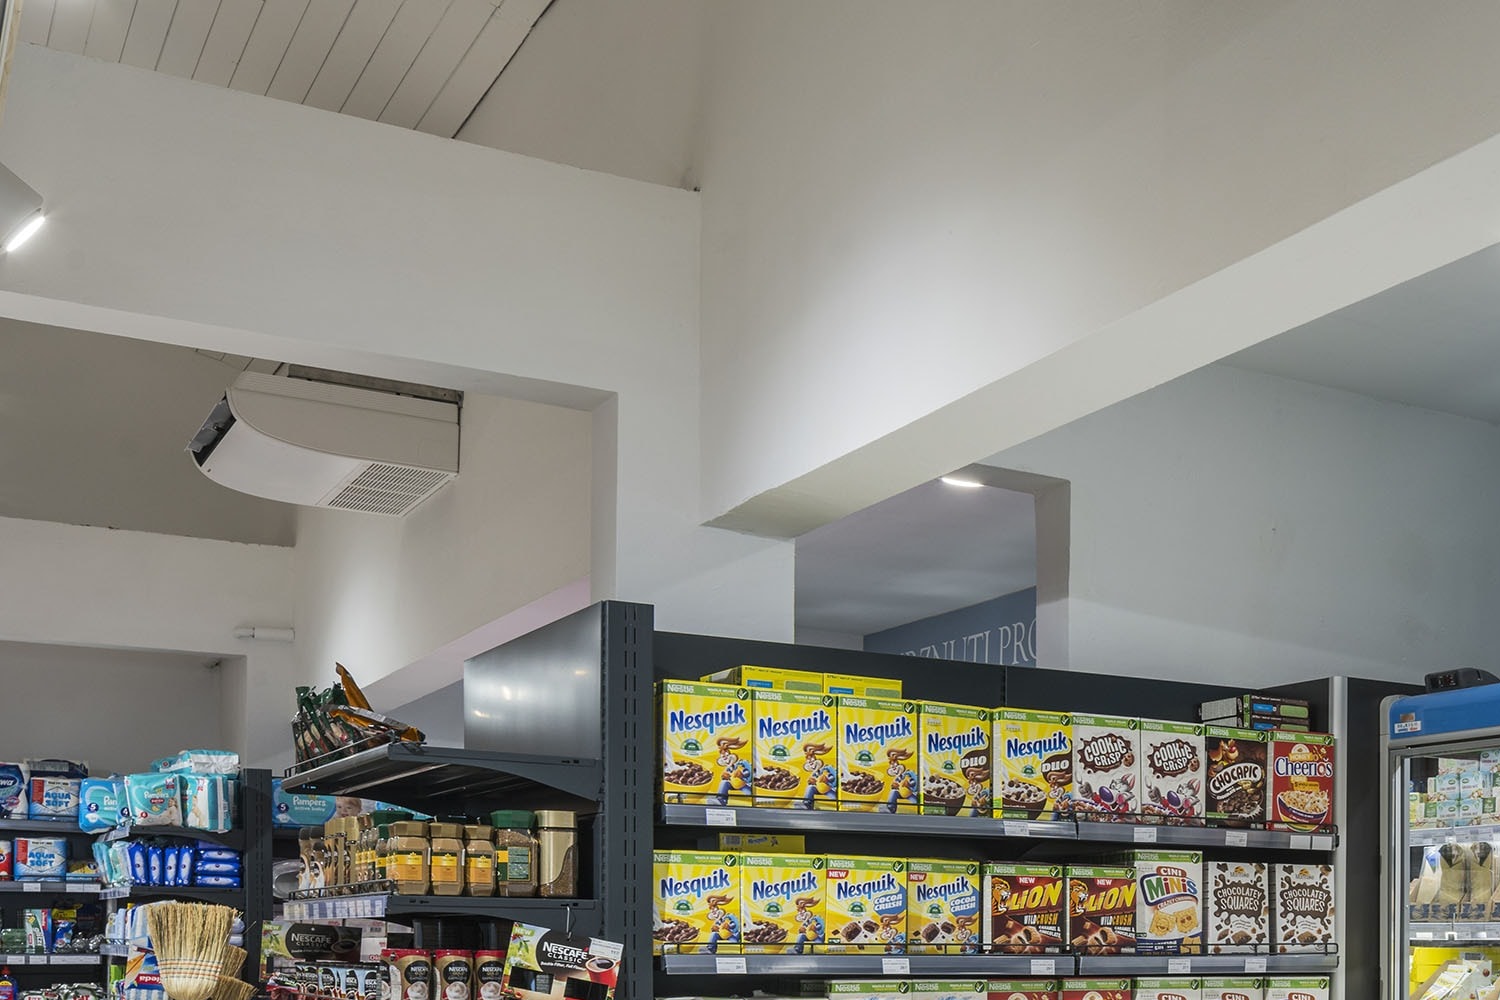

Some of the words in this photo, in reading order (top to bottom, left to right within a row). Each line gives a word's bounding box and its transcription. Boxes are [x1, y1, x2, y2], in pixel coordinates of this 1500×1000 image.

[670, 703, 746, 734] Nesquik
[759, 711, 831, 739] Nesquik
[845, 717, 912, 745] Nesquik
[927, 727, 986, 753] Nesquik
[1007, 731, 1068, 759] Nesquik
[1275, 757, 1332, 778] Cheerios
[1210, 765, 1262, 792] CHOCAPIC
[44, 792, 71, 800] AQUA
[46, 800, 70, 808] SOFT
[292, 795, 327, 808] Pampers
[1019, 877, 1035, 885] NEW
[1160, 867, 1183, 876] CINI
[661, 869, 730, 897] Nesquik
[753, 872, 817, 900] Nesquik
[836, 873, 896, 900] Nesquik
[917, 877, 969, 901] Nesquik
[1217, 888, 1262, 899] CHOCOLATEY
[1220, 898, 1259, 911] SQUARES
[1284, 890, 1328, 900] CHOCOLATEY
[1287, 899, 1325, 912] SQUARES
[547, 953, 582, 963] CLASSIC
